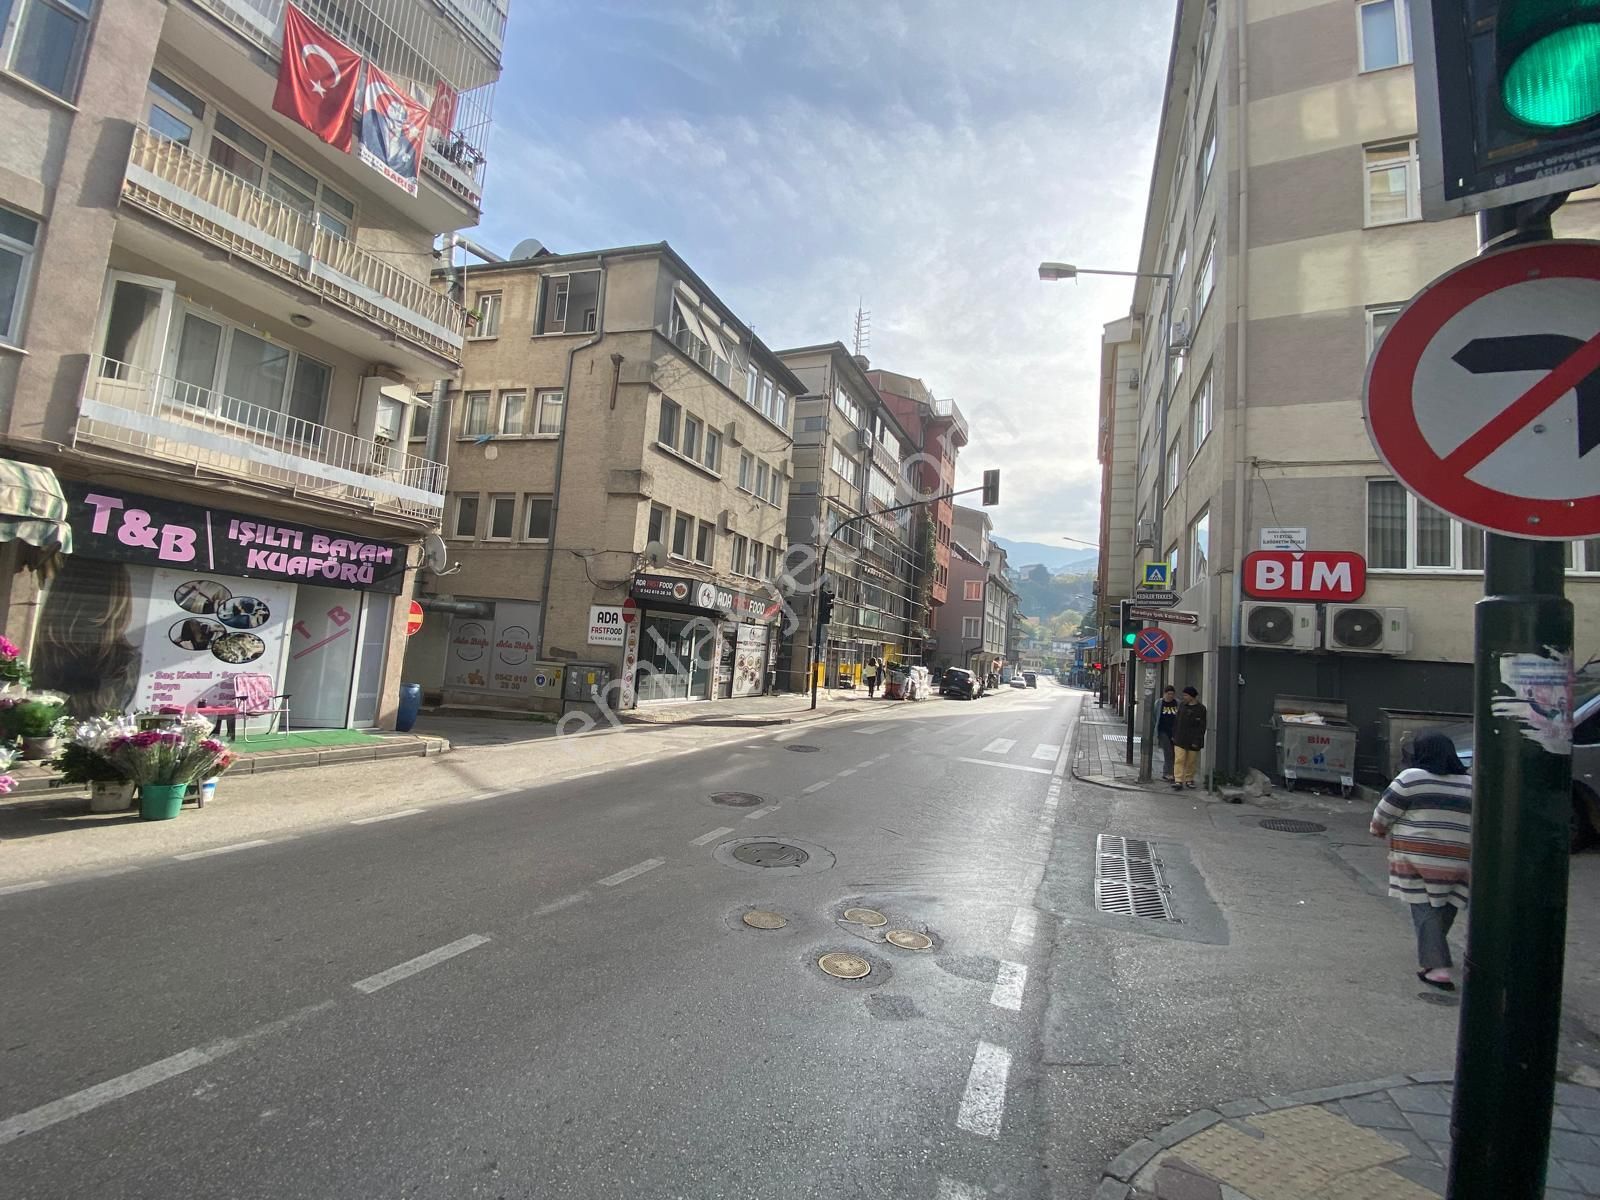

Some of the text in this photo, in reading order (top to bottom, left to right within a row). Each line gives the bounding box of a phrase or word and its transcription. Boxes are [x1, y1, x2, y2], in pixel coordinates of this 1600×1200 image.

[84, 493, 197, 562] T&B
[228, 519, 393, 565] IŞILTI BAYAN
[246, 548, 374, 584] KUAFÖRÜ
[1256, 553, 1353, 592] BİM
[635, 579, 646, 587] ADA
[717, 591, 733, 609] ADA
[327, 606, 351, 627] B
[597, 611, 618, 625] ADA
[591, 626, 623, 635] FASTFOOD
[155, 671, 176, 681] Saç
[177, 671, 212, 679] Kesimi
[1307, 735, 1331, 745] BİM
